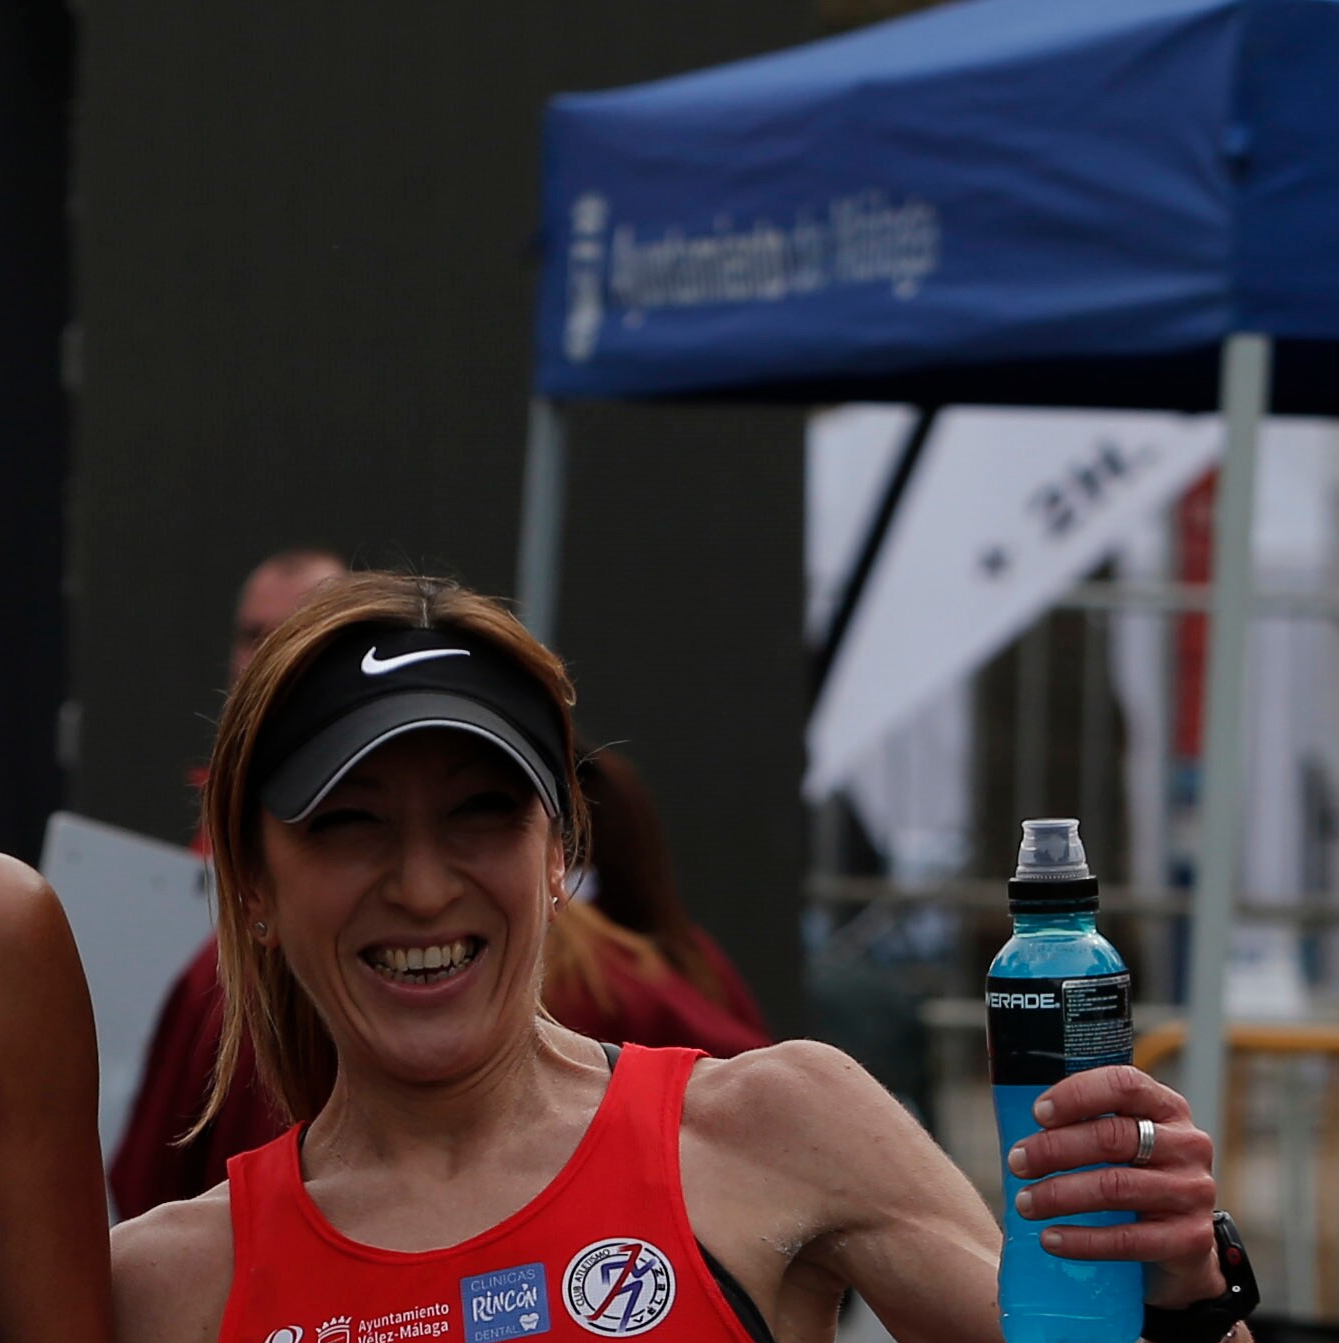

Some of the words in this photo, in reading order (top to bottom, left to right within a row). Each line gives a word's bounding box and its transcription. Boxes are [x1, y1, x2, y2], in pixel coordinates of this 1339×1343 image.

[576, 1249, 611, 1283] ATLETISMO
[470, 1268, 536, 1291] CLINICAS
[573, 1286, 585, 1306] CLUB
[357, 1302, 450, 1333] Ayuntamiento
[474, 1325, 522, 1342] DENTAL
